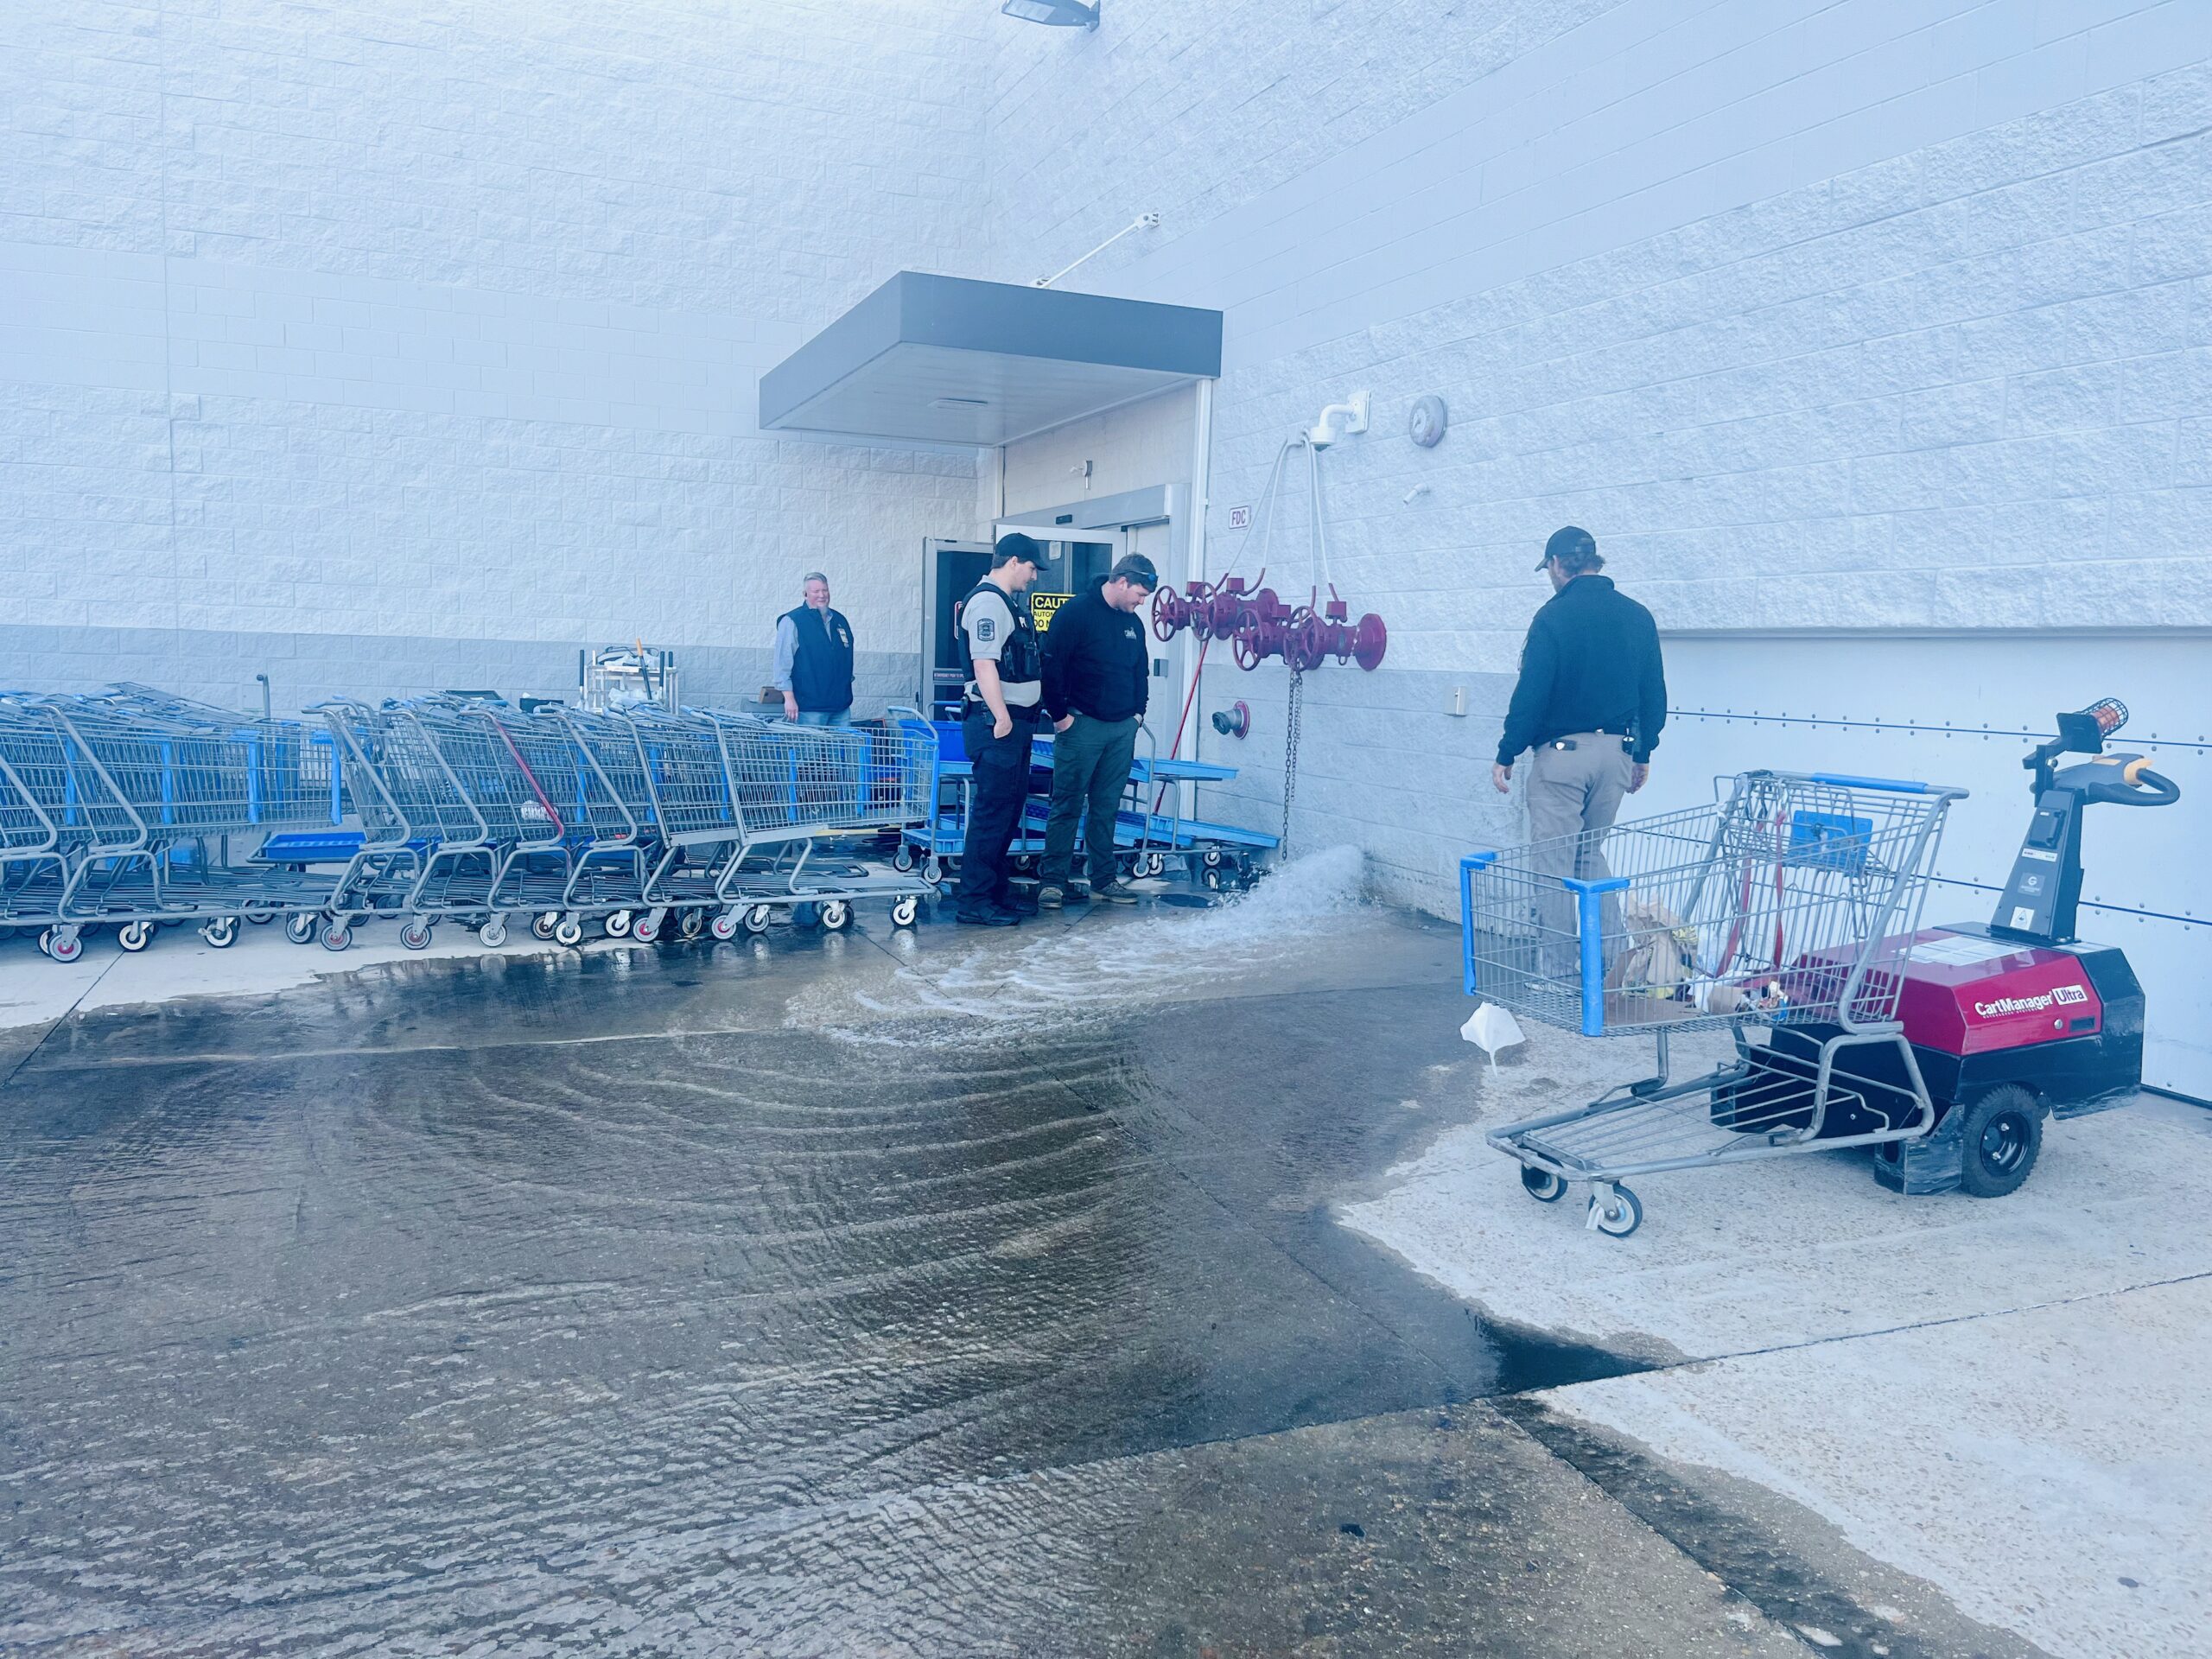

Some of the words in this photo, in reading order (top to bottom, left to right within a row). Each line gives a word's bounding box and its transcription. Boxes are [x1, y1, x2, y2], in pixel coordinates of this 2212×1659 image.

[1231, 510, 1246, 525] FDC
[1974, 994, 2053, 1016] CartManager
[2056, 989, 2085, 1003] Ultra
